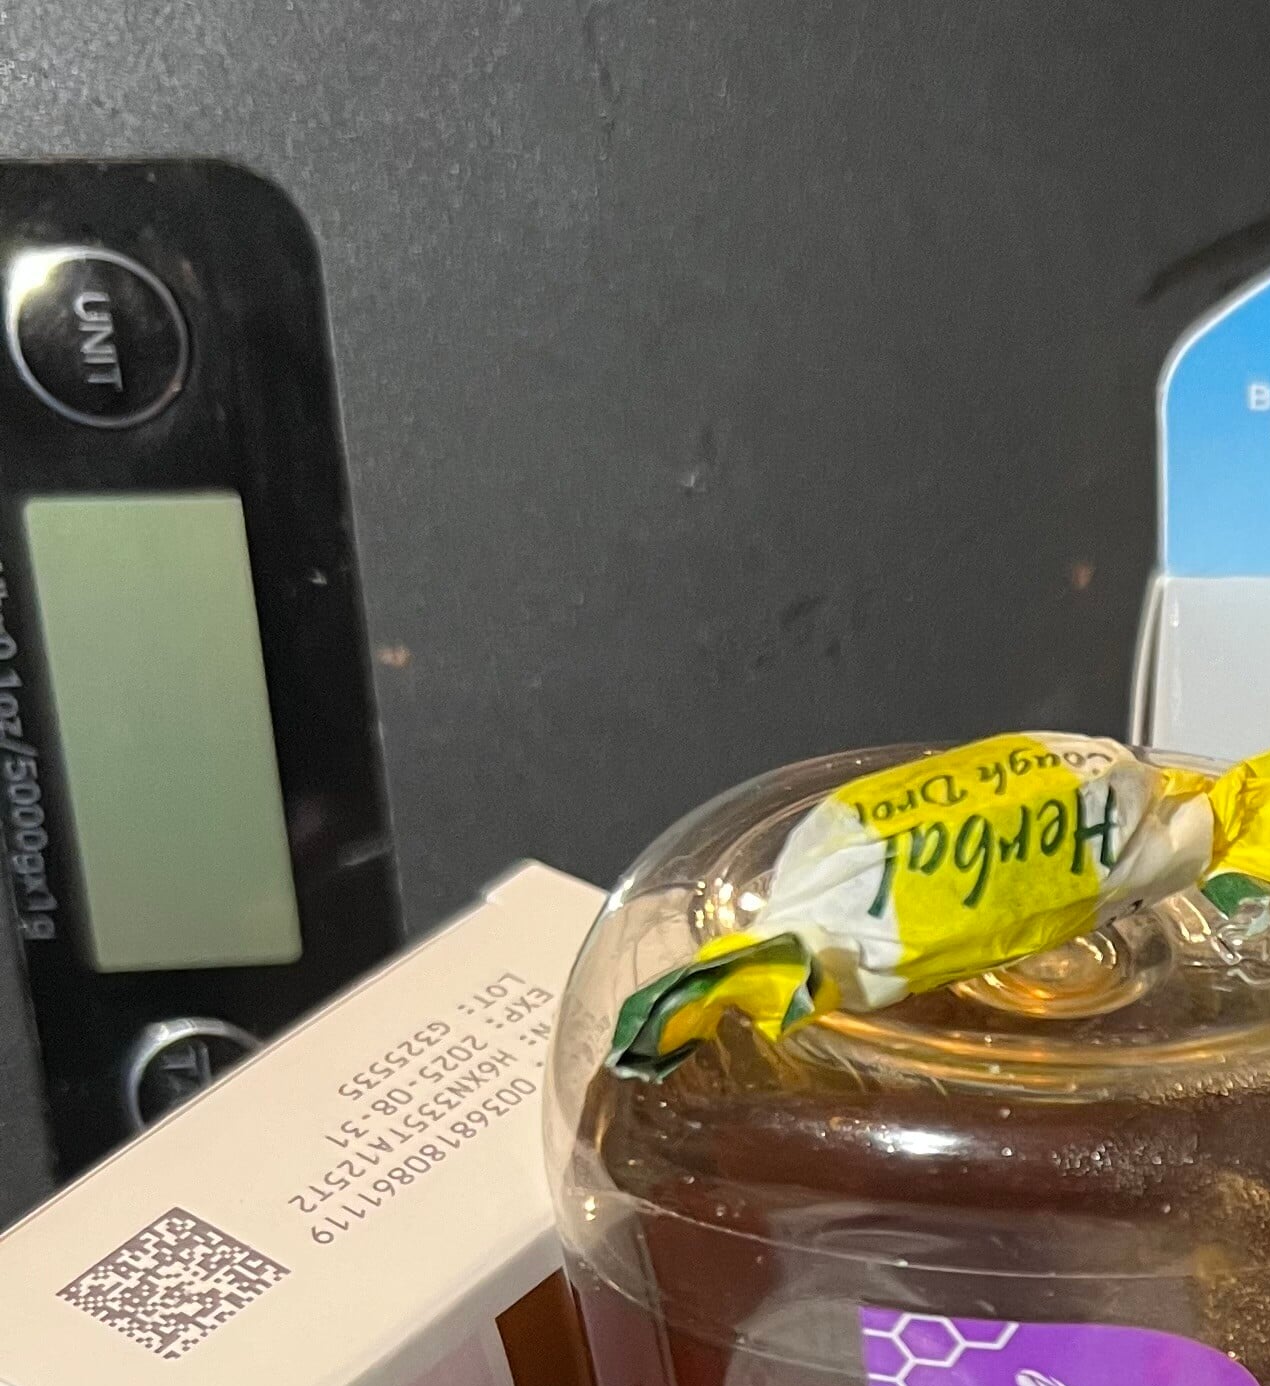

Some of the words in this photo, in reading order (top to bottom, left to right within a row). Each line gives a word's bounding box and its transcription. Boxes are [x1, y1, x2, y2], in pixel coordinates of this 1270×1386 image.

[74, 290, 123, 392] UNIT
[977, 747, 1114, 796] Cough
[867, 780, 1116, 918] Herbal
[457, 971, 527, 1016] LOT:
[485, 986, 557, 1033] EXP:
[519, 1019, 556, 1049] N:
[323, 1033, 490, 1151] 2025-08-31
[337, 1021, 452, 1102] G325535
[287, 1050, 519, 1216] H6XN335TA125T2
[308, 1076, 538, 1247] 00368180861119
